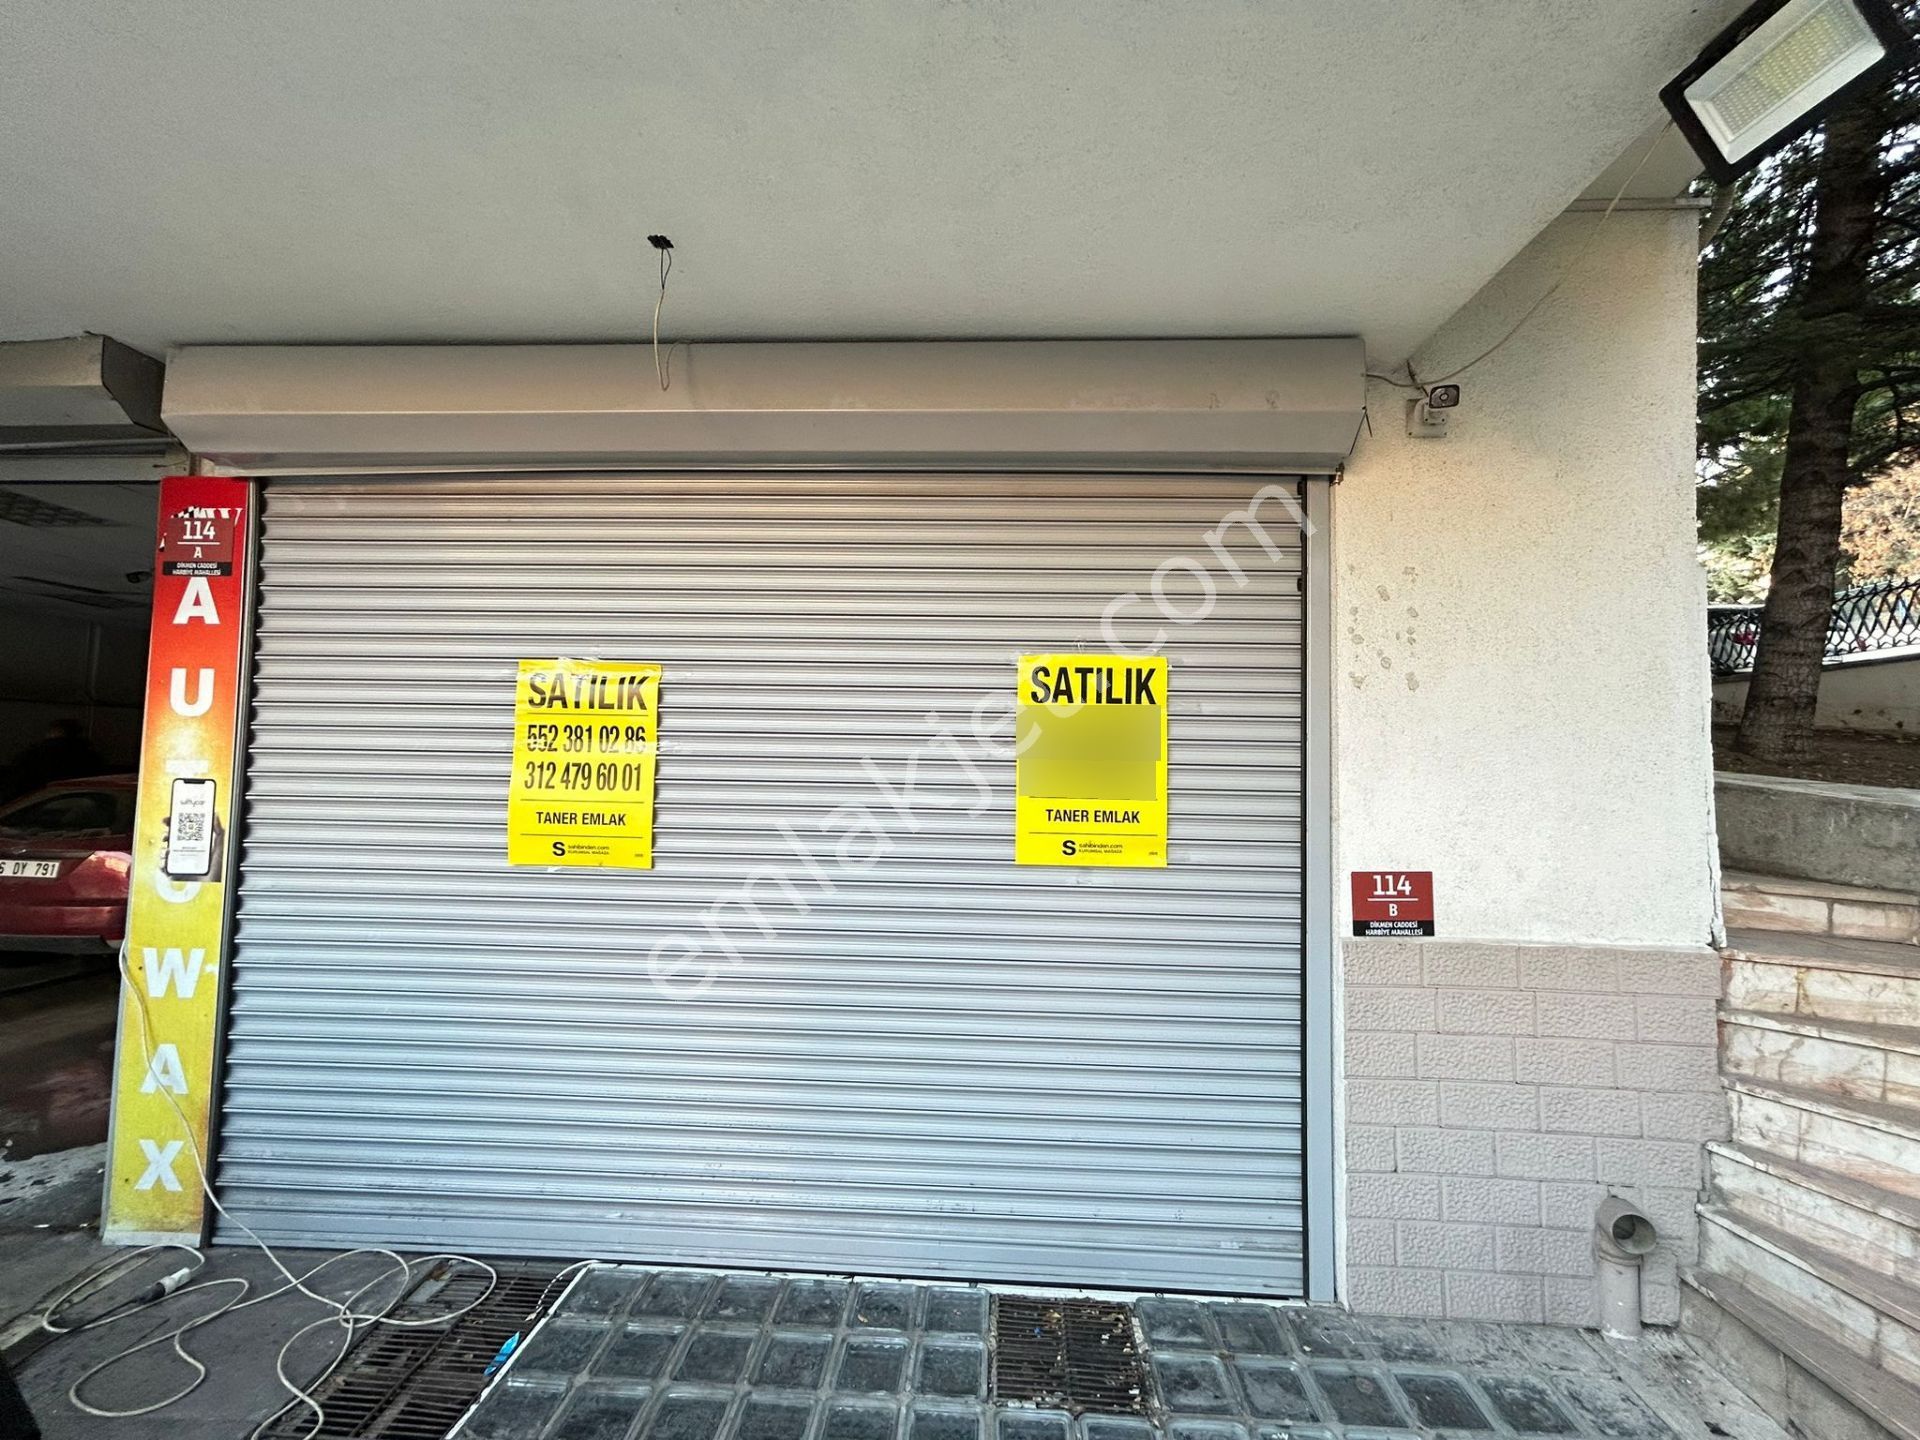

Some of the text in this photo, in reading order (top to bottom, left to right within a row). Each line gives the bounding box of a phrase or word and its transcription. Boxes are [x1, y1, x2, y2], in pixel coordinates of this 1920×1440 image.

[182, 520, 216, 540] 114
[193, 546, 202, 559] A
[527, 672, 649, 710] SATILIK
[1031, 666, 1156, 705] SATILIK
[527, 724, 647, 754] 552 381 02 86
[524, 761, 642, 792] 312 479 60 01
[536, 811, 627, 827] TANER EMLAK
[1045, 808, 1140, 824] TANER EMLAK
[552, 841, 566, 857] S
[1062, 840, 1077, 856] S
[12, 861, 28, 875] DY
[34, 862, 56, 877] 791
[1373, 874, 1412, 896] 114
[1388, 903, 1398, 917] B
[1365, 928, 1423, 936] HARBİYE MAHALLESİ
[1394, 920, 1418, 928] CADDESİ
[134, 947, 206, 1192] WAX
